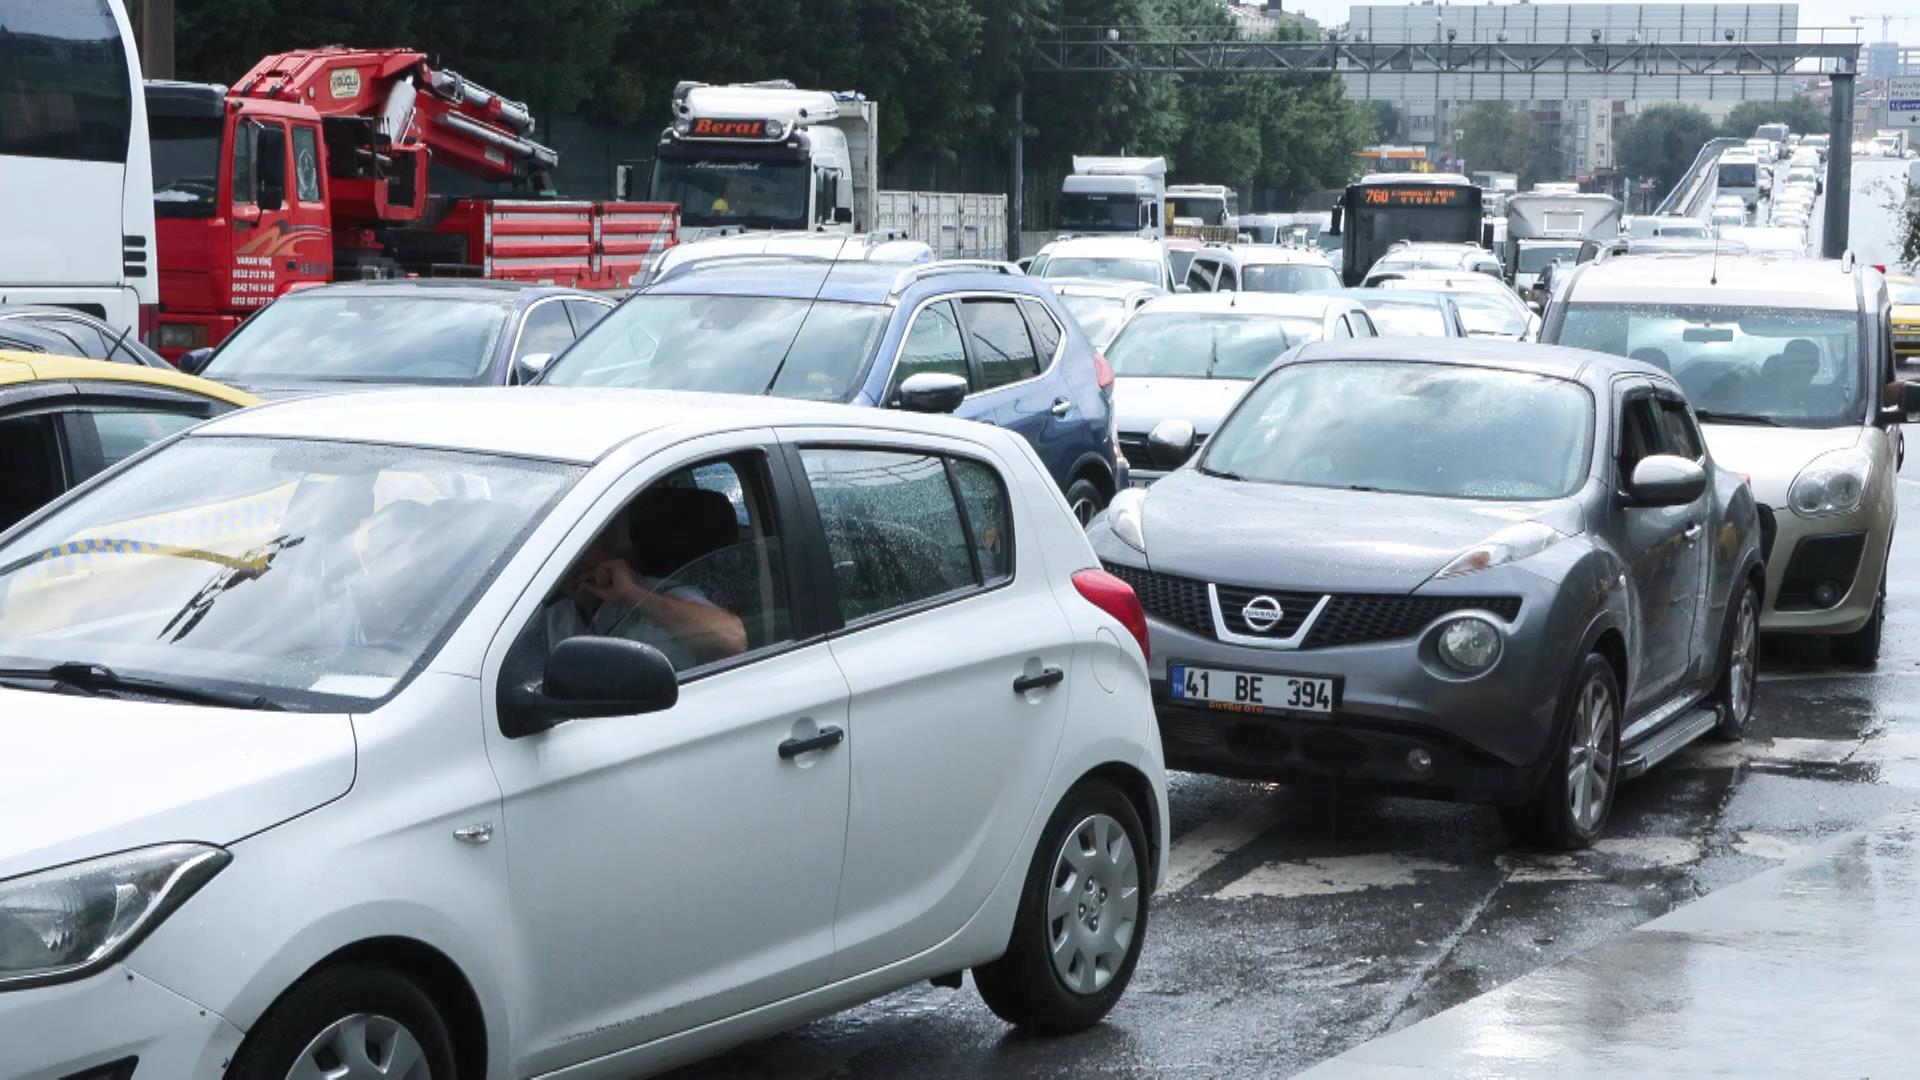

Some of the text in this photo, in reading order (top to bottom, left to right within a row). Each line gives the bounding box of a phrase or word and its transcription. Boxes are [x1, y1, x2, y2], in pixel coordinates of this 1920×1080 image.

[694, 118, 762, 135] Berat
[1366, 189, 1389, 204] 760
[1244, 609, 1280, 619] NISSAN
[1172, 683, 1184, 693] TR
[1185, 670, 1330, 709] 41 BE 394
